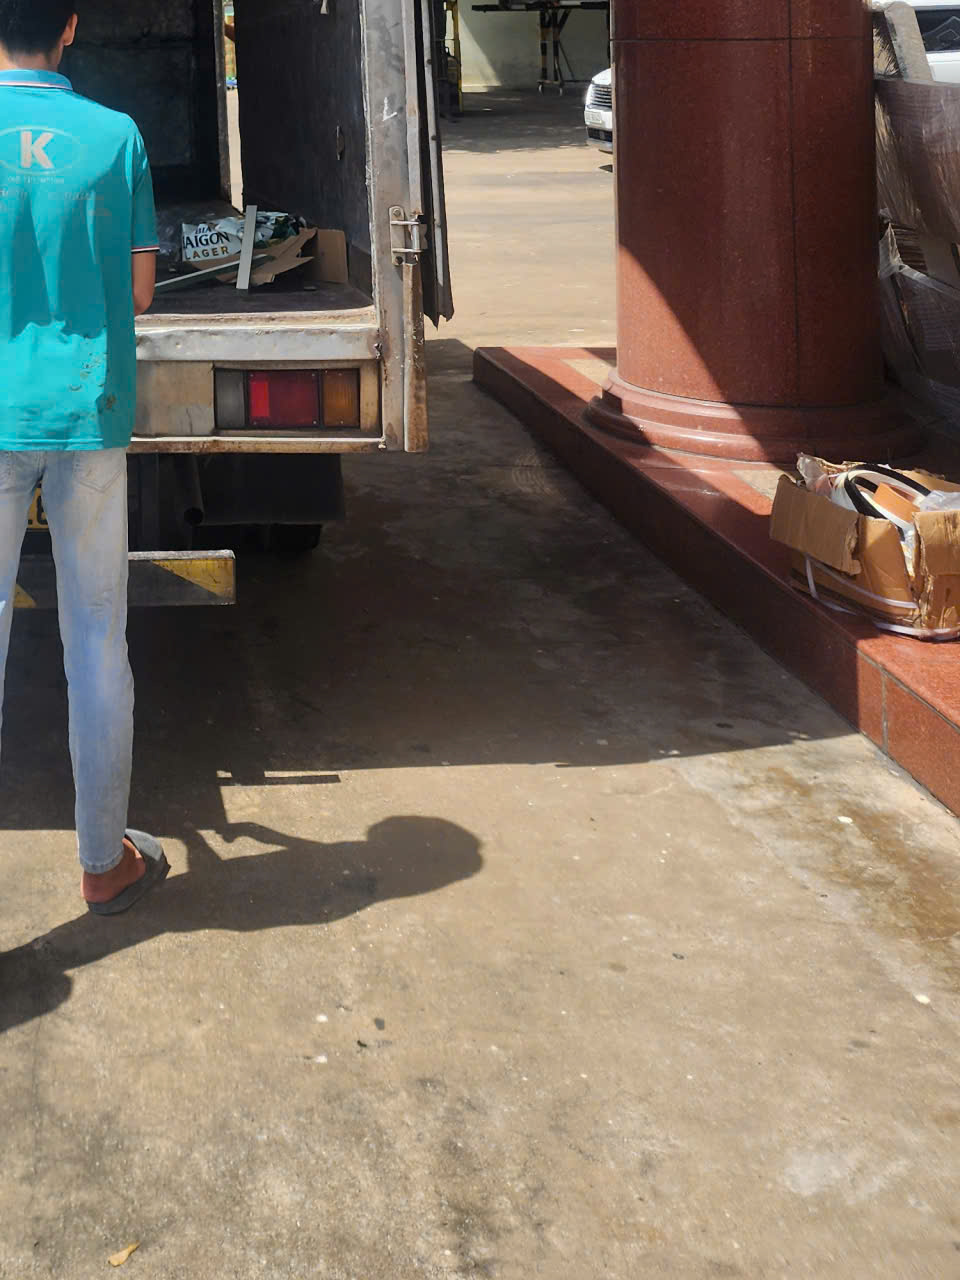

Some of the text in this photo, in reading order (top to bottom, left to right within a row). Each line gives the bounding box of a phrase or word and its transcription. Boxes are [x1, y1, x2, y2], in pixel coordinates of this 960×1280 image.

[20, 130, 55, 169] K
[182, 231, 231, 250] AIGON
[185, 245, 230, 261] LAGER
